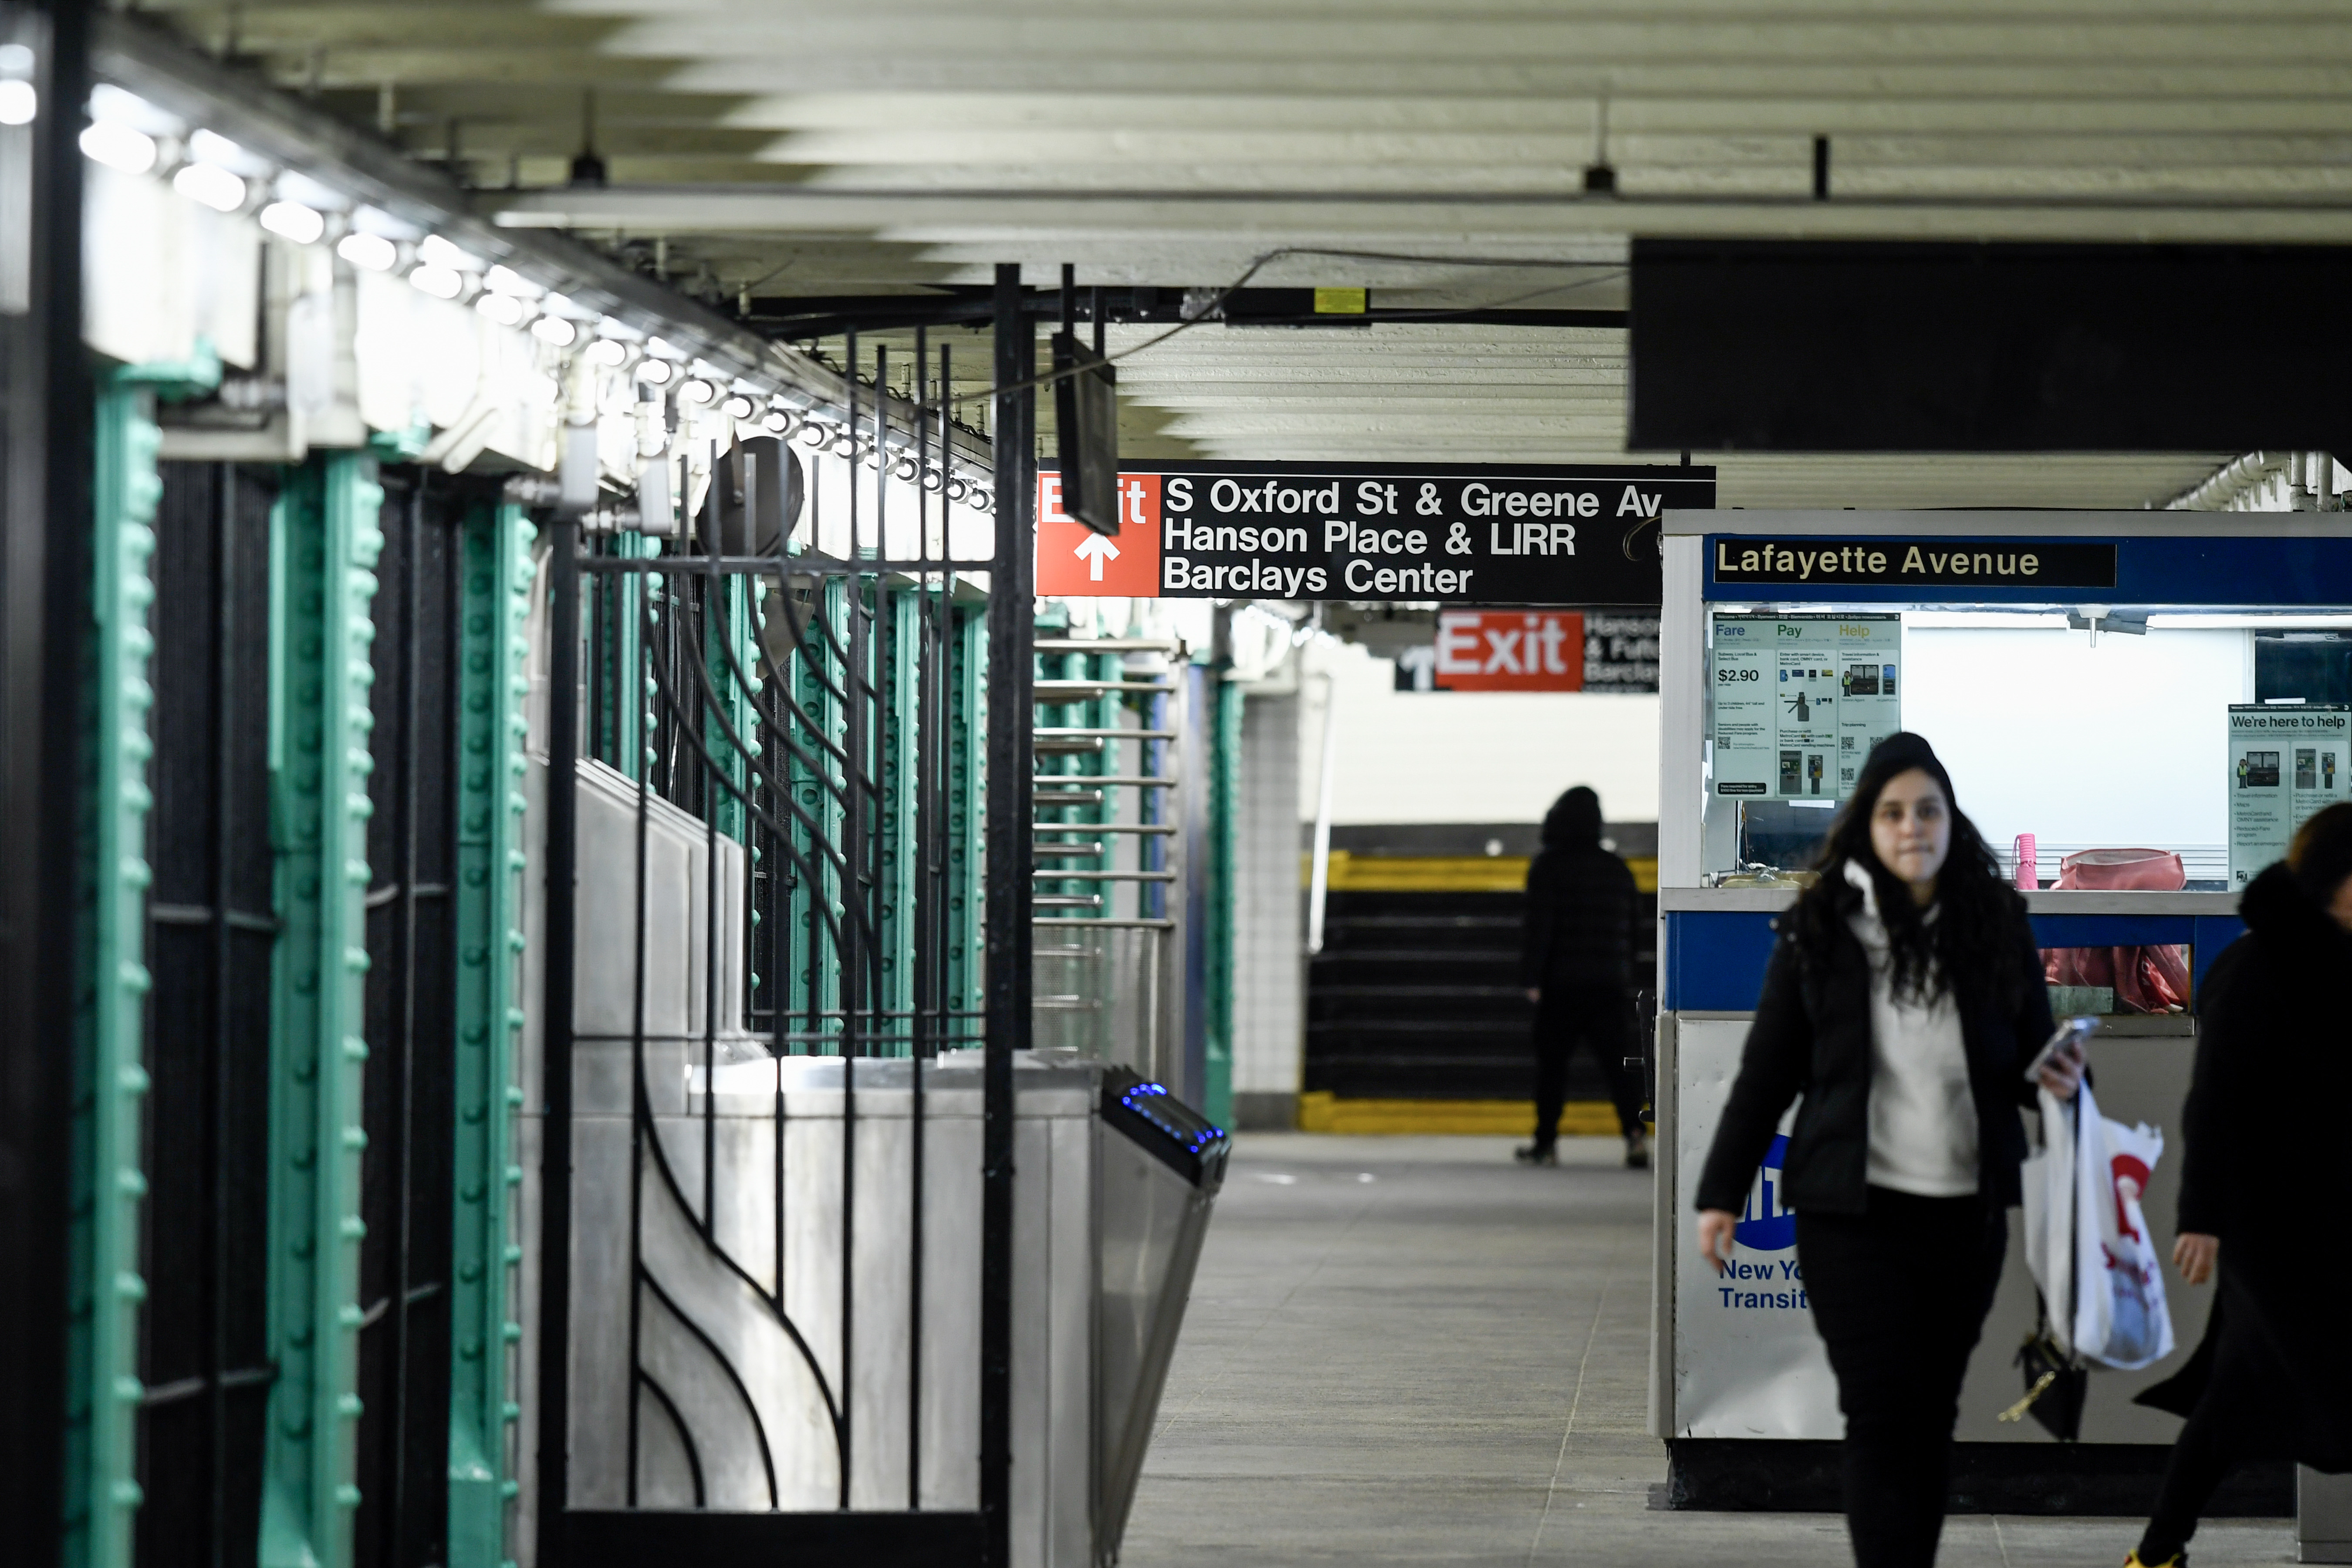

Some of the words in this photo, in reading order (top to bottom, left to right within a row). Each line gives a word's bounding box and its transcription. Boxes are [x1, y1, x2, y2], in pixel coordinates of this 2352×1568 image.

[1041, 477, 1146, 524] Eit
[1166, 478, 1193, 512] S
[1210, 479, 1339, 514] Oxford
[1356, 481, 1398, 515] St
[1415, 482, 1443, 515] &
[1461, 483, 1600, 517] Greene
[1615, 485, 1662, 517] Av
[1165, 517, 1308, 552] Hanson
[1325, 520, 1428, 555] Place
[1445, 522, 1473, 555] &
[1490, 522, 1576, 555] LIRR
[1718, 544, 1888, 579] Lafayette
[1900, 546, 2040, 575] Avenue
[1163, 556, 1328, 598] Barclays
[1344, 559, 1473, 594] Center
[1716, 625, 1745, 636] Fare
[1778, 625, 1802, 638] Pay
[1839, 625, 1870, 638] Help
[1436, 615, 1568, 675] Exit
[1718, 669, 1759, 683] $2.90
[2231, 716, 2266, 727] We're
[2270, 716, 2299, 727] here
[2302, 716, 2315, 727] to
[2318, 716, 2345, 729] help
[1720, 1260, 1774, 1281] New
[1719, 1288, 1807, 1309] Transit
